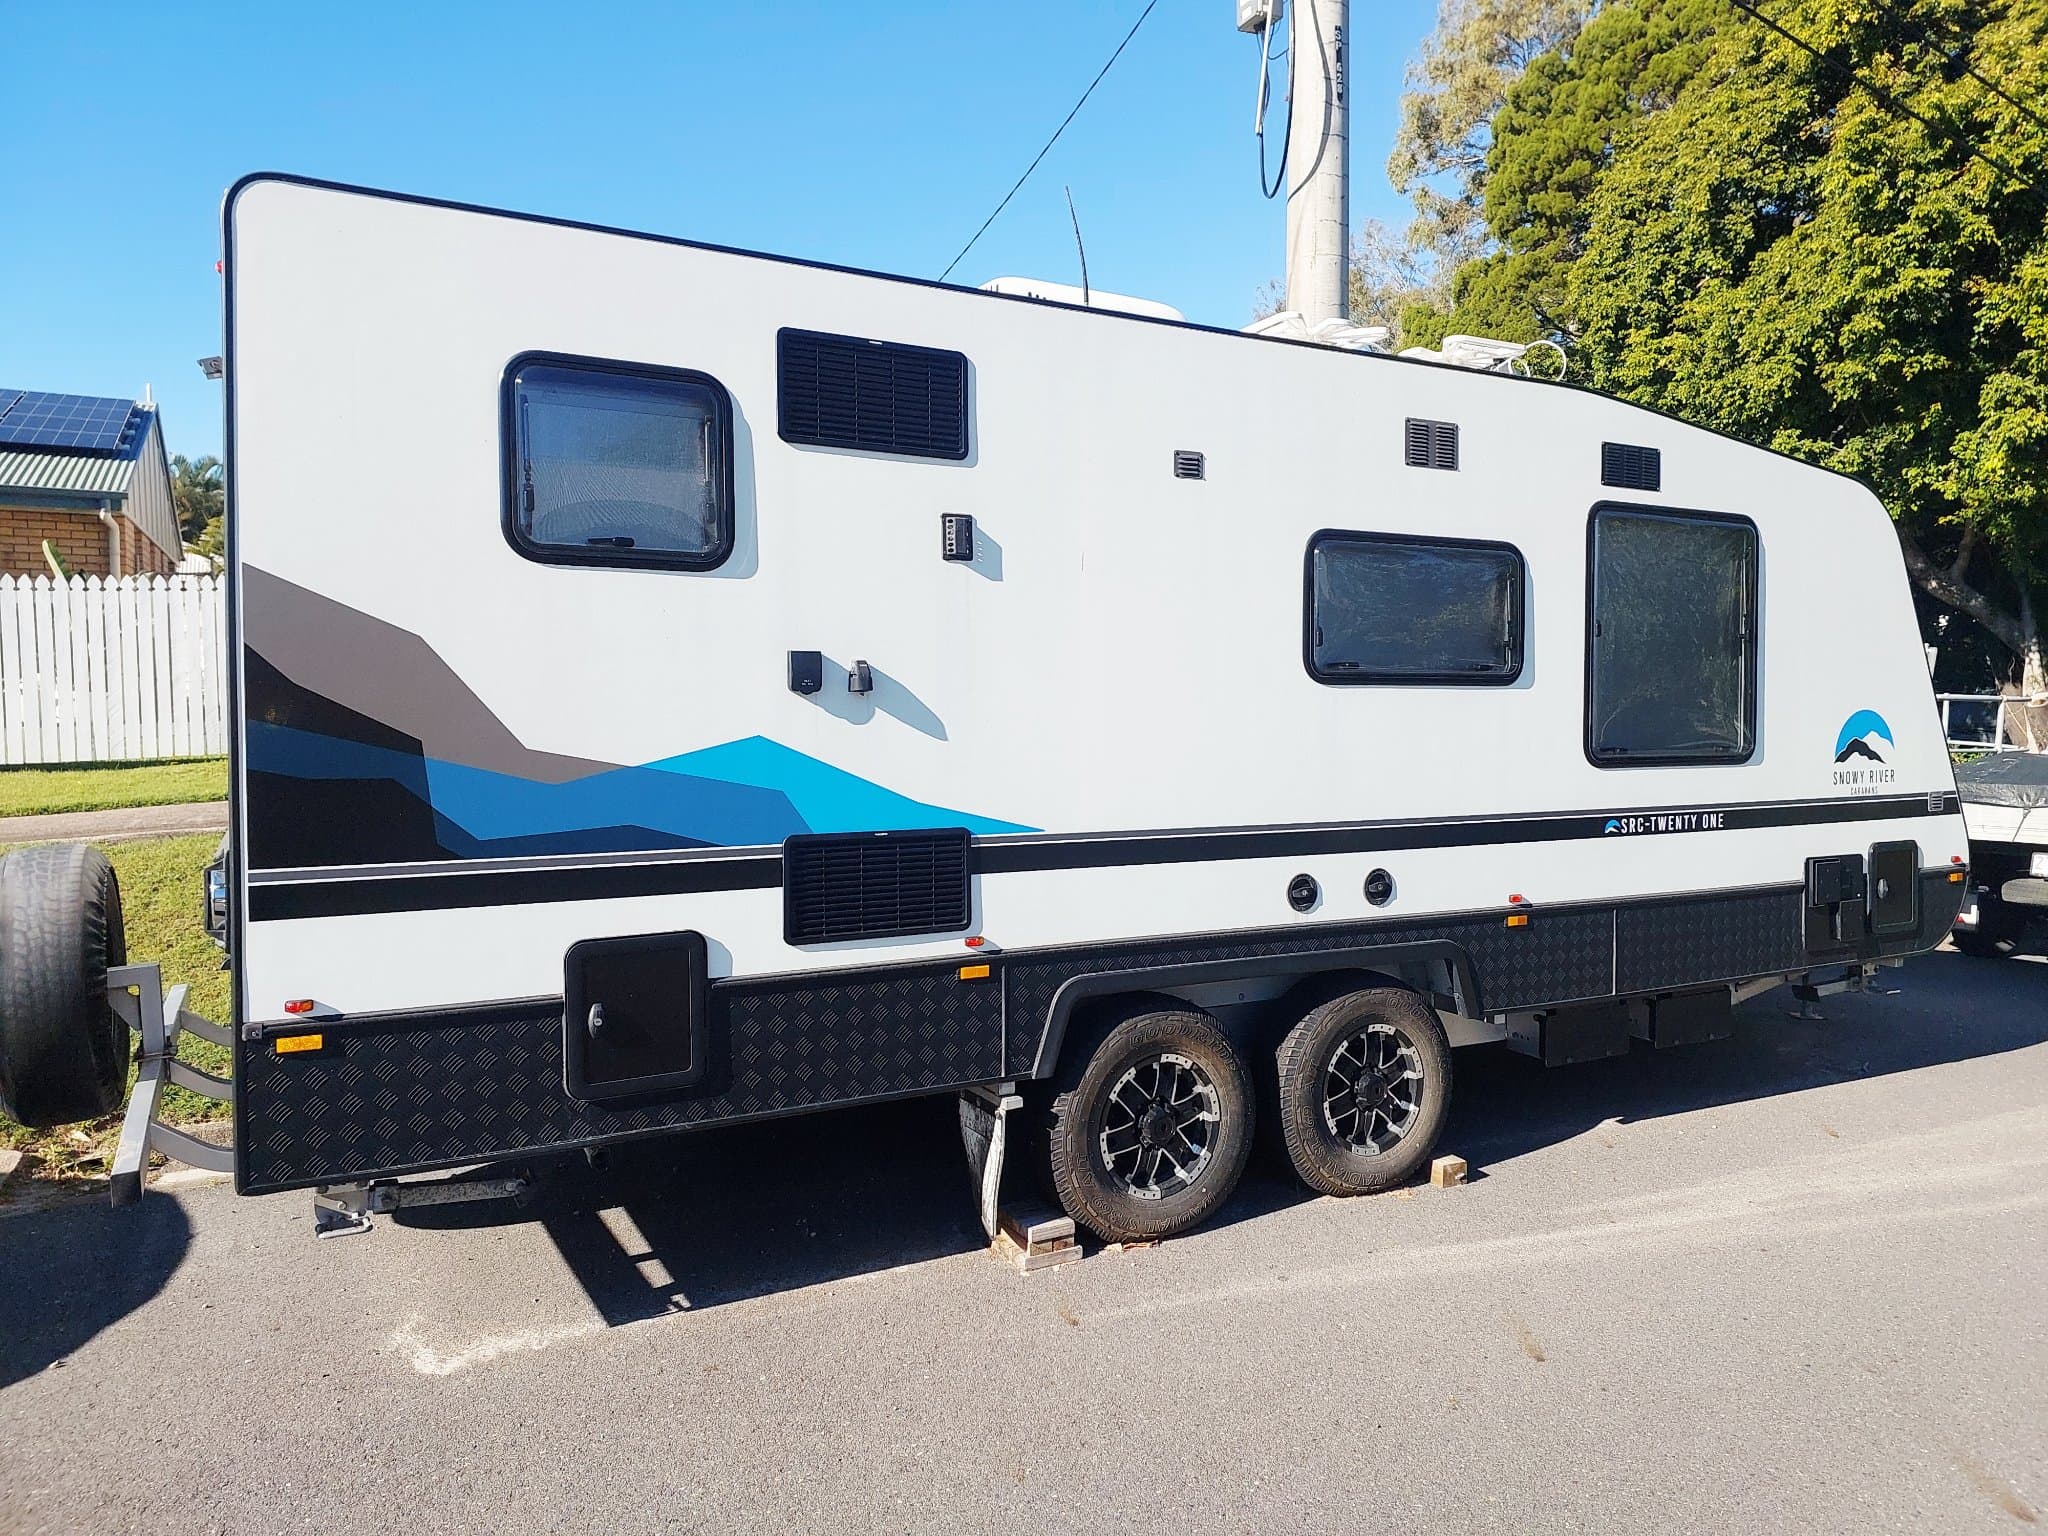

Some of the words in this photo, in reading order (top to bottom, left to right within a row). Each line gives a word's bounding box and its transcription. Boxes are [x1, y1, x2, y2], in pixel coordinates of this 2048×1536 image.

[1833, 769, 1865, 786] SNOWY
[1869, 769, 1895, 784] RIVER
[1850, 786, 1878, 796] CARAVANS
[1620, 815, 1697, 834] SRC-TWENTY
[1702, 813, 1724, 829] ONE
[1325, 1156, 1387, 1187] RADIAL
